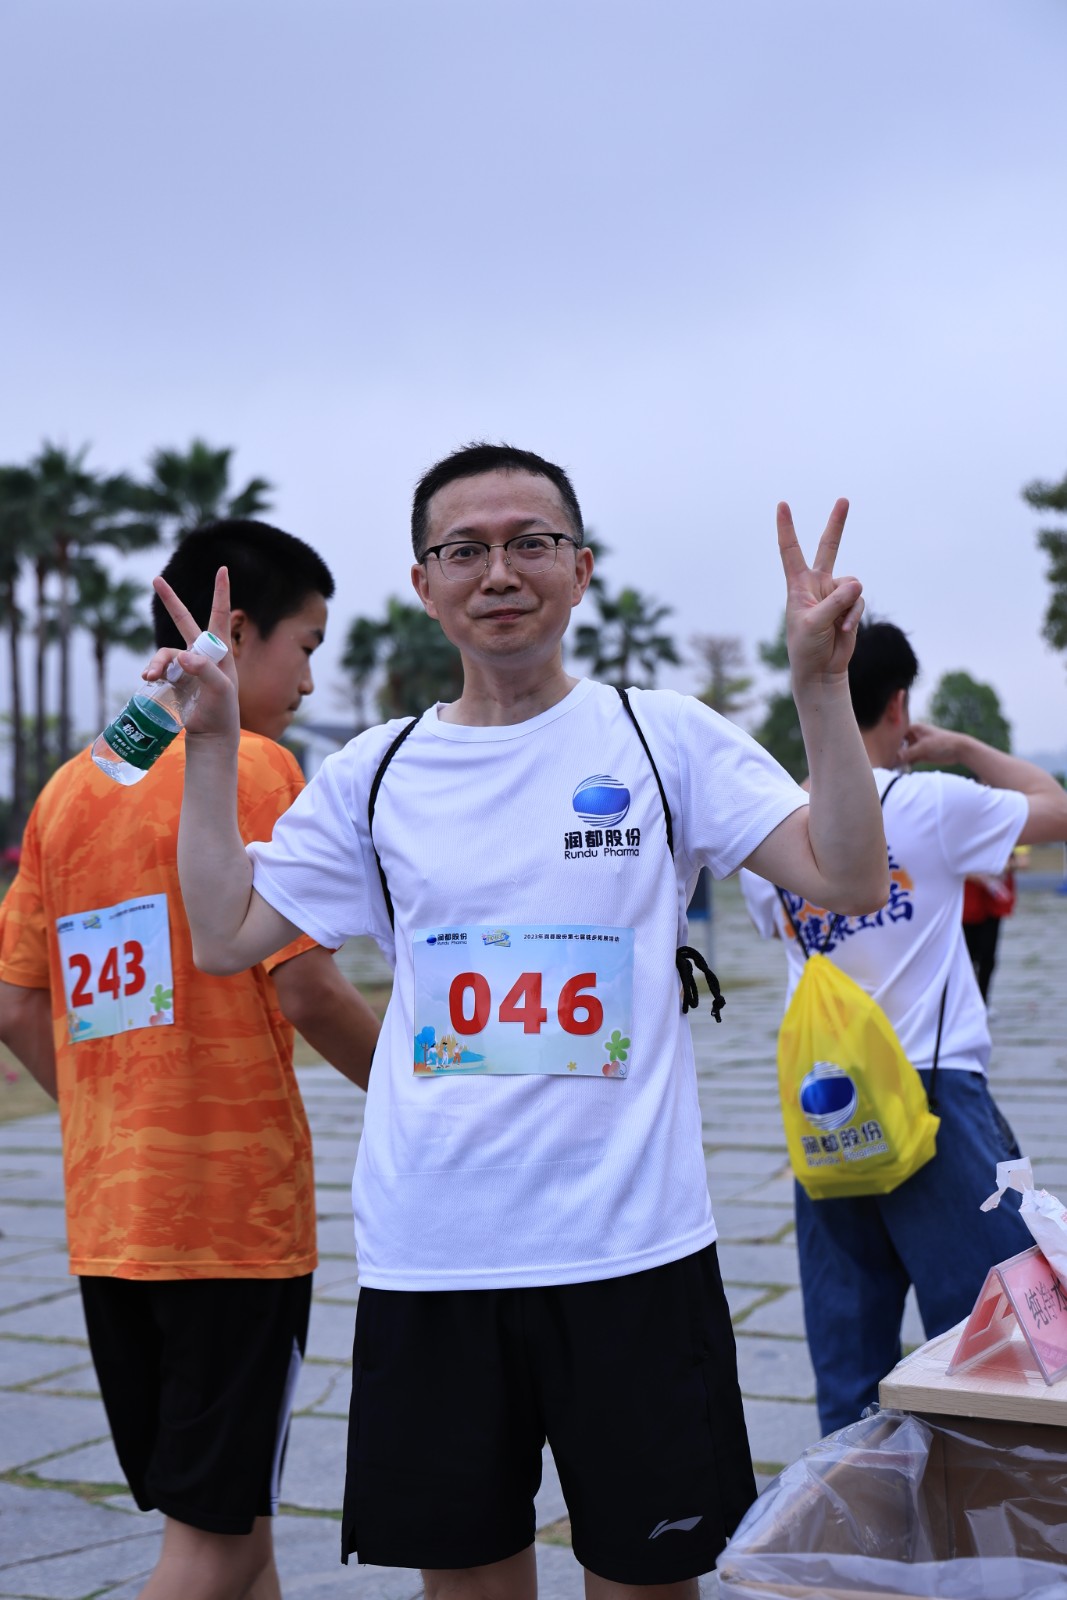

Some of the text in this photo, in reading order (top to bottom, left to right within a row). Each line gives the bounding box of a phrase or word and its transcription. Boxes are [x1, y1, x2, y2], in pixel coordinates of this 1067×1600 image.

[564, 828, 641, 849] 润都股份
[564, 848, 640, 860] Rundu Pharma
[437, 933, 467, 941] 润都股份
[68, 940, 147, 1009] 243
[448, 972, 604, 1035] 046
[801, 1120, 883, 1154] 润都股份
